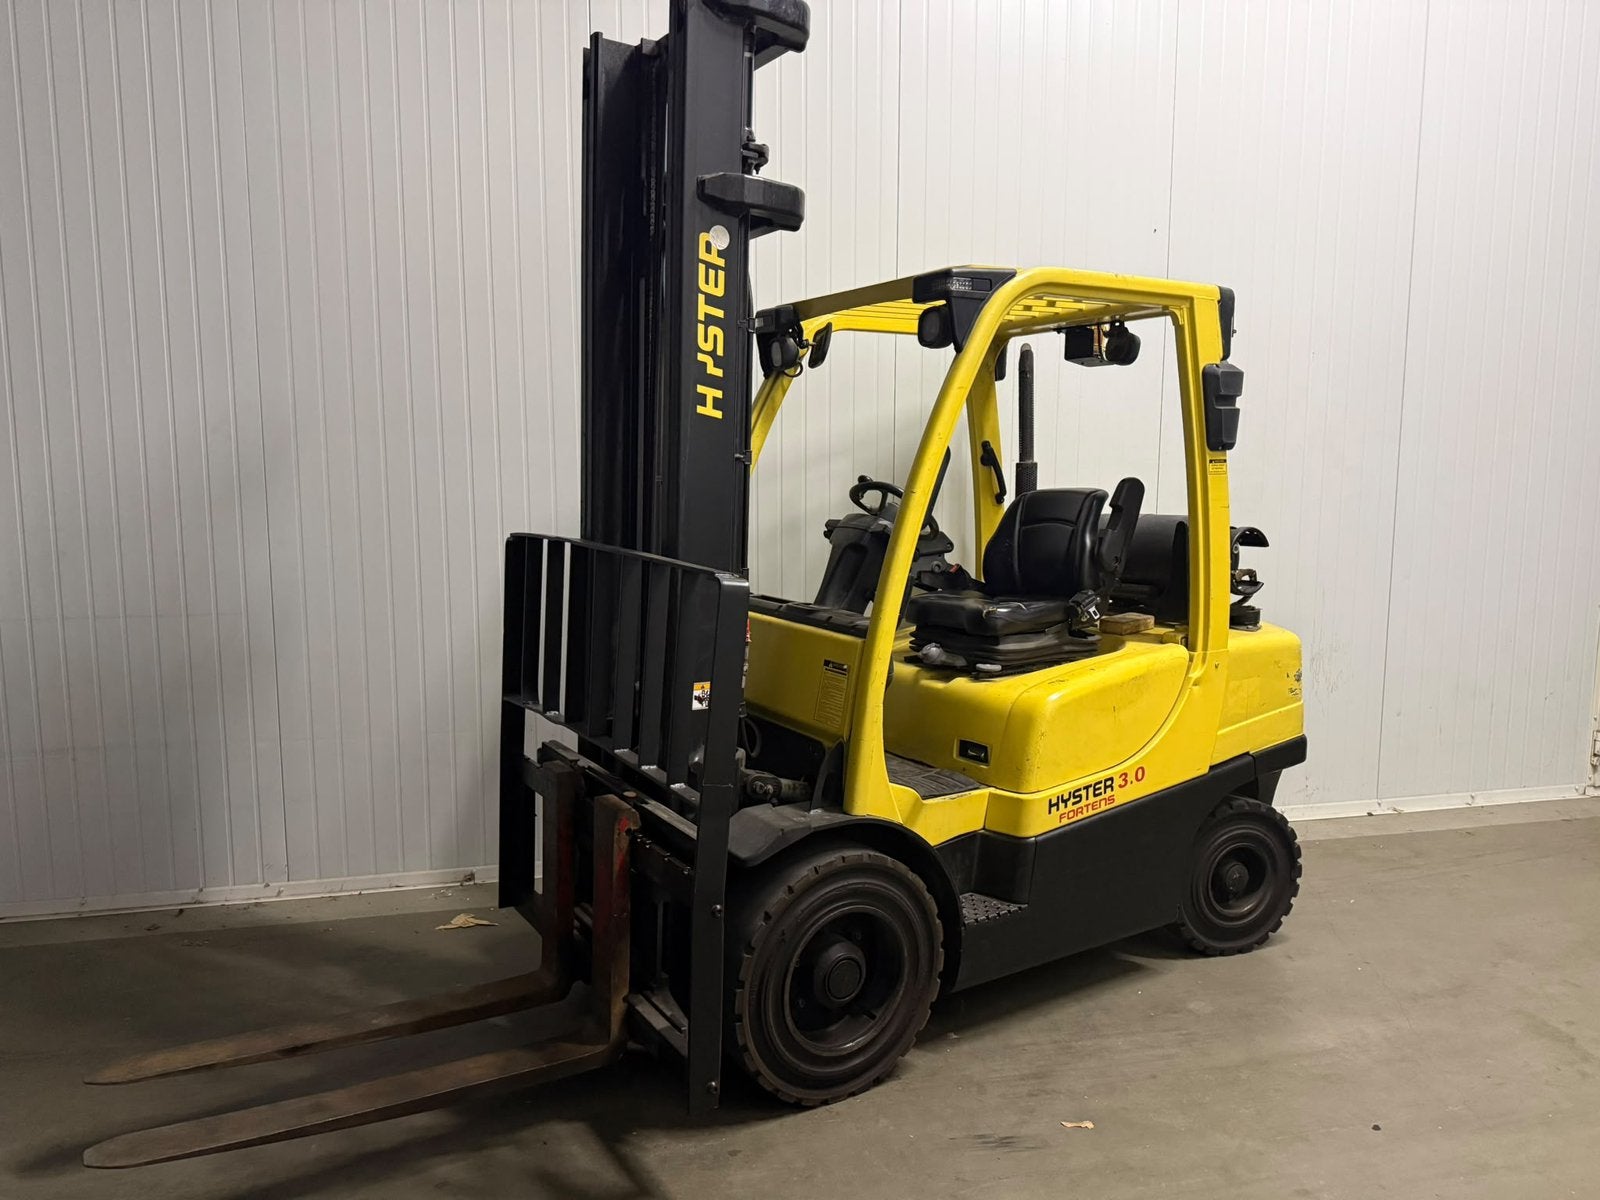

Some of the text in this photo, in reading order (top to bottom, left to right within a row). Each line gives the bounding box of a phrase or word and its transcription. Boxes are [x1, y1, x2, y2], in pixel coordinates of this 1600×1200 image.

[1048, 766, 1146, 815] HYSTER 3.0
[1059, 795, 1115, 823] FORTENS
